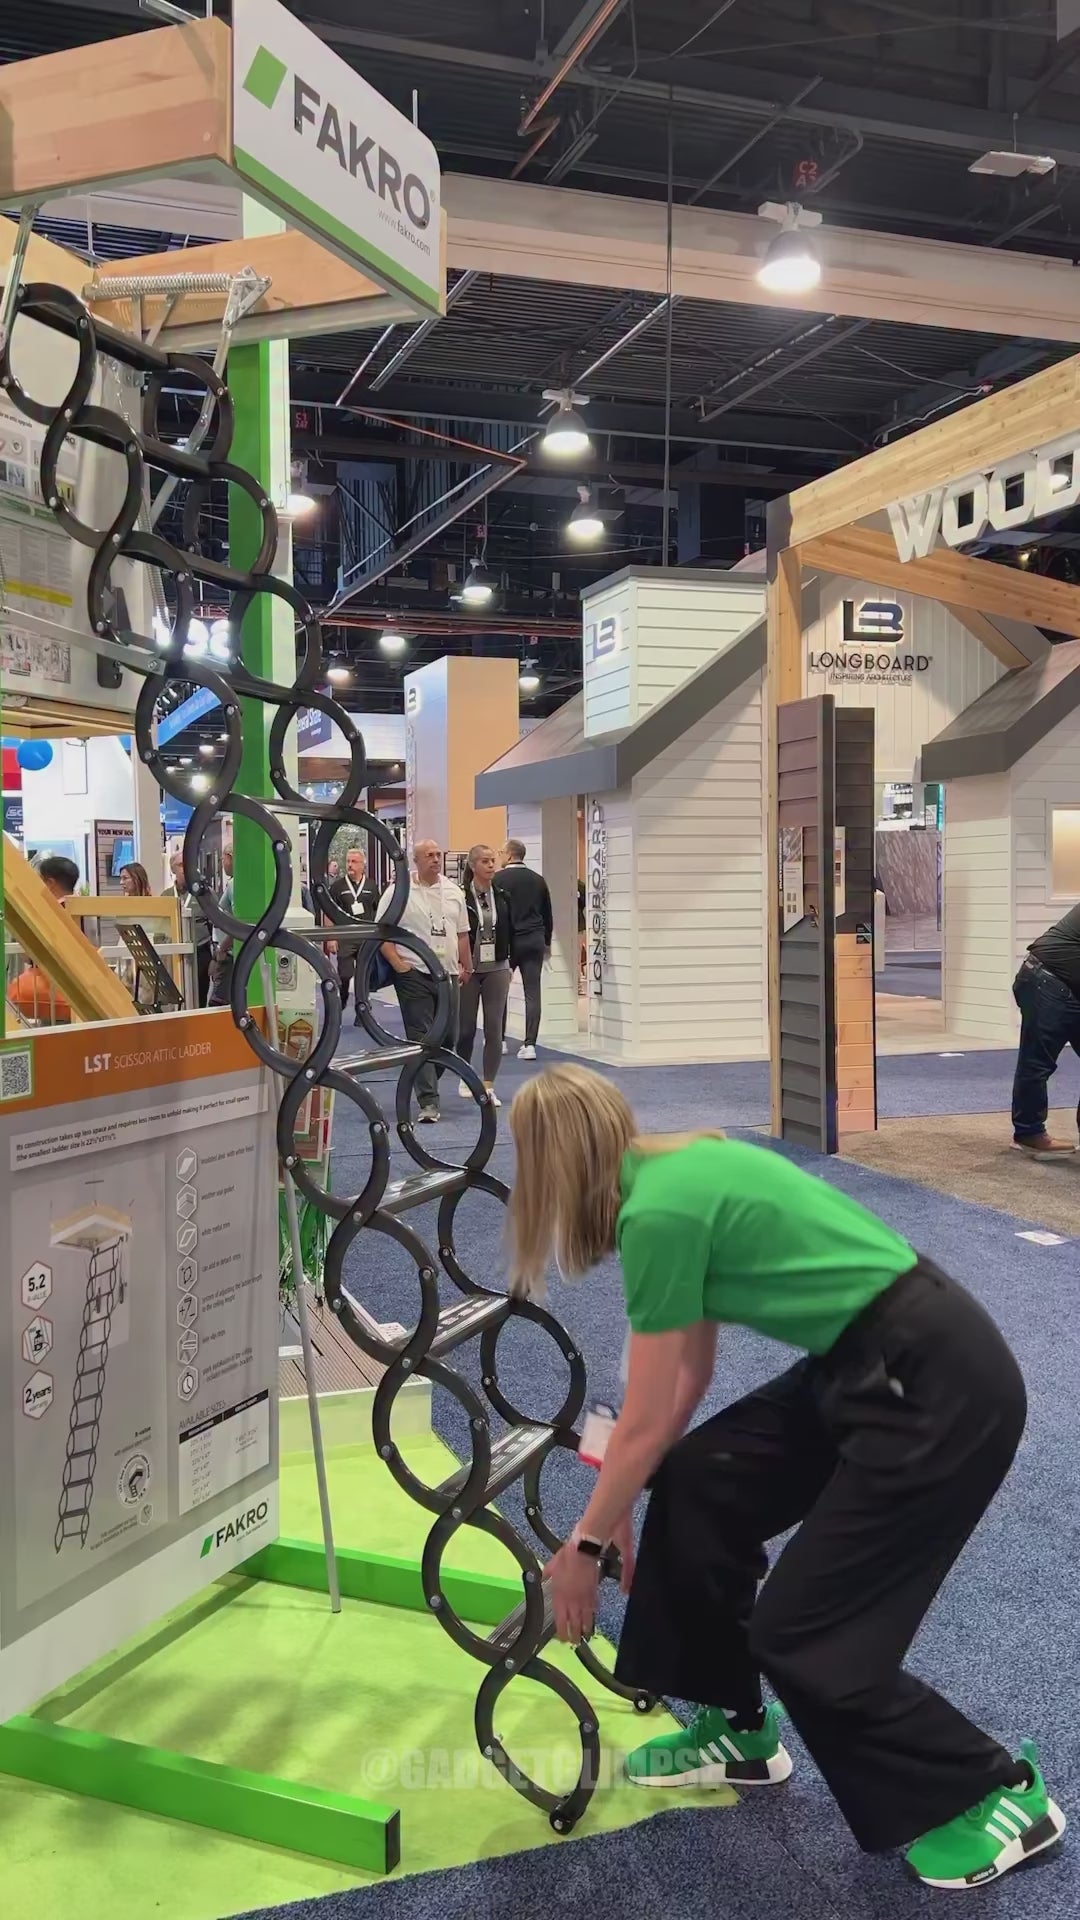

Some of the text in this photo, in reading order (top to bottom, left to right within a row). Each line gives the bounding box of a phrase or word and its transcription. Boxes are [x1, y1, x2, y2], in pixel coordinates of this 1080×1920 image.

[294, 73, 431, 231] FAKRO
[378, 208, 432, 257] www.fakro.com
[843, 600, 904, 642] LB
[810, 651, 930, 672] LONGBOARD
[592, 801, 604, 997] LONGBOARD
[84, 1042, 212, 1074] LST SCISSOR ATTIC LADDER
[24, 1137, 58, 1149] construction
[59, 1133, 73, 1141] takes
[74, 1131, 81, 1139] up
[92, 1126, 107, 1135] space
[28, 1273, 46, 1292] 5.2
[216, 1502, 268, 1548] FAKRO
